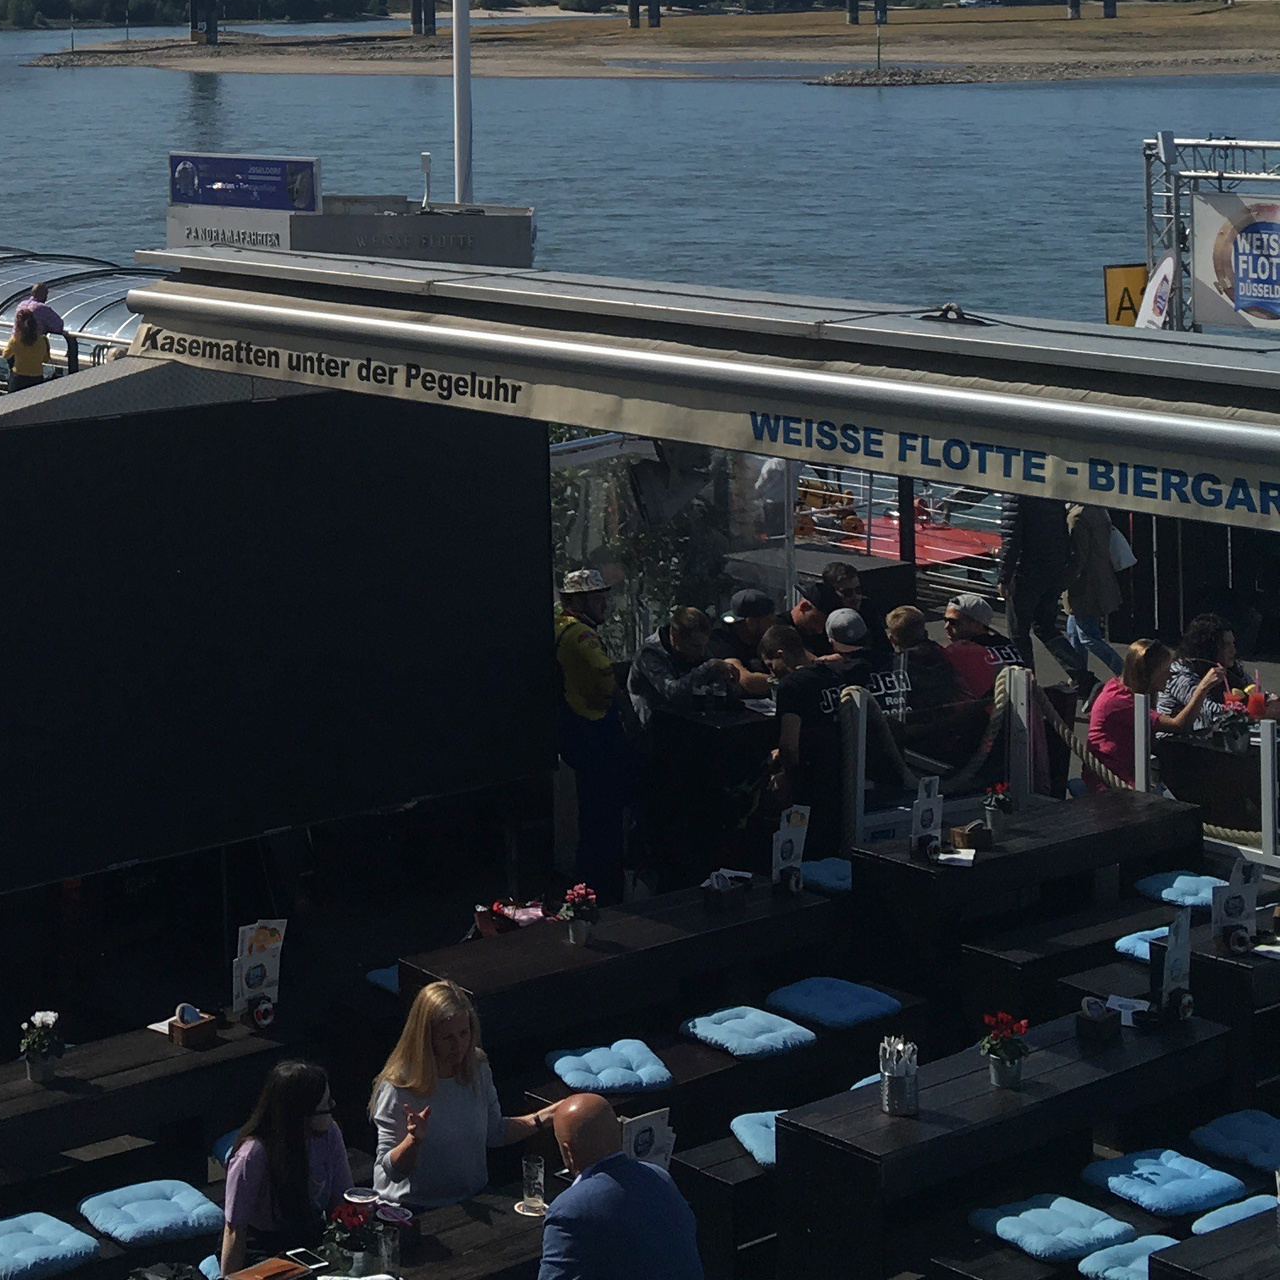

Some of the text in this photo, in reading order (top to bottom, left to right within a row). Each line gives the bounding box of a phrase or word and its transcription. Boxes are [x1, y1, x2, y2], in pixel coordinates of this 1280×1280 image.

[141, 326, 522, 404] Kasematten unter der Pegeluhr
[749, 411, 884, 459] WEISSE
[898, 431, 1047, 484] FLOTTE
